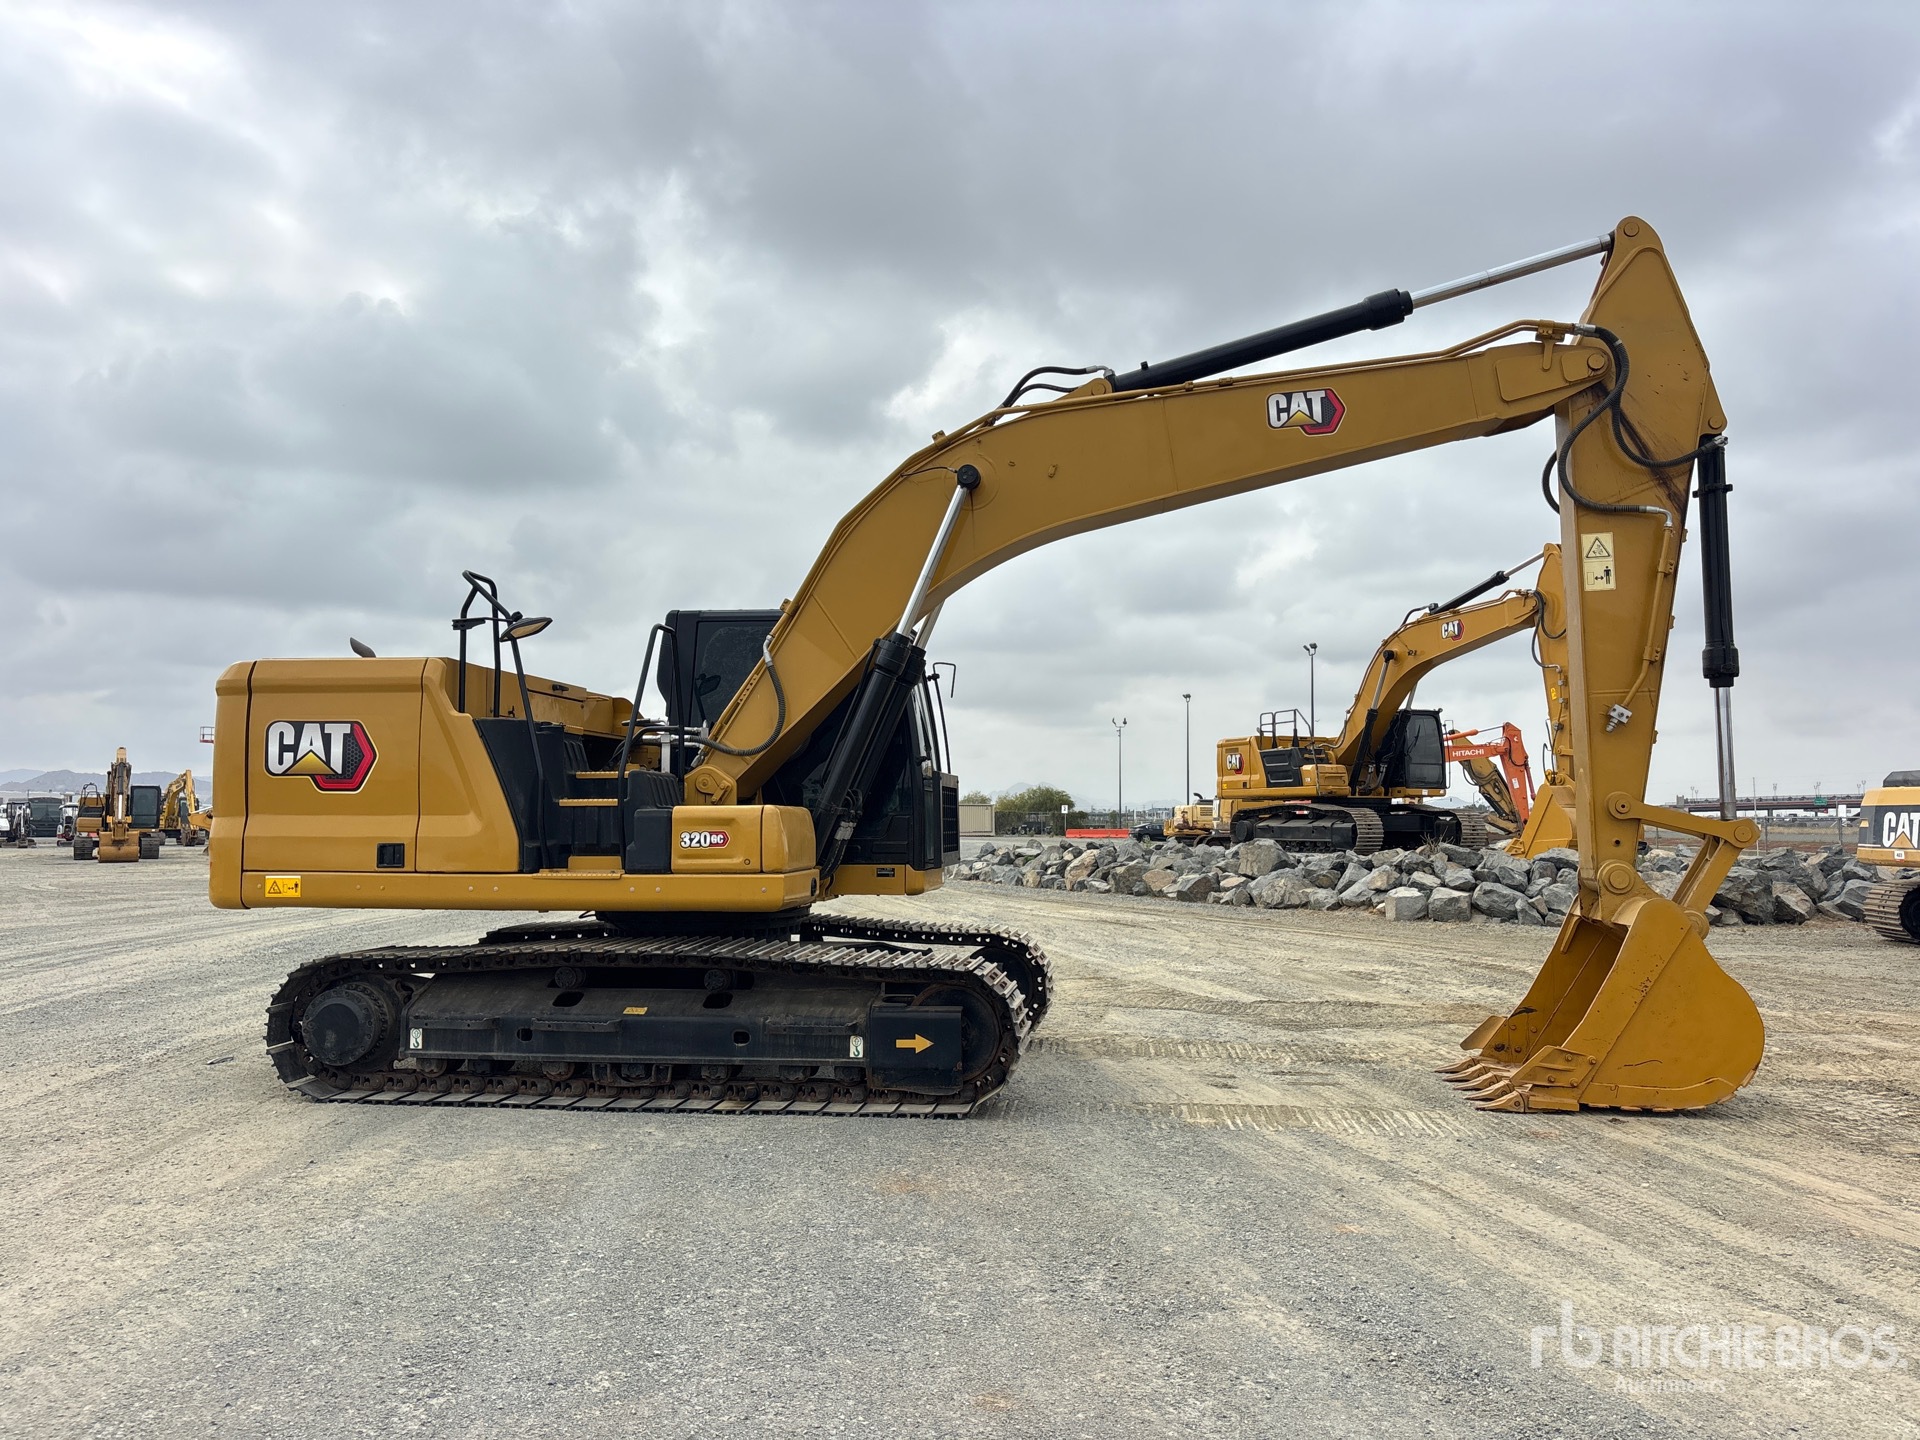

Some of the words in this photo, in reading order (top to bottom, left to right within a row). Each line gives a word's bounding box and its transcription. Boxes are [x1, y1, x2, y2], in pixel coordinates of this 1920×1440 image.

[1268, 390, 1326, 428] CAT
[1441, 620, 1459, 639] CAT
[267, 721, 351, 775] CAT
[1226, 754, 1241, 770] CAT
[1452, 748, 1485, 757] HITACHI
[1882, 811, 1920, 849] CAT
